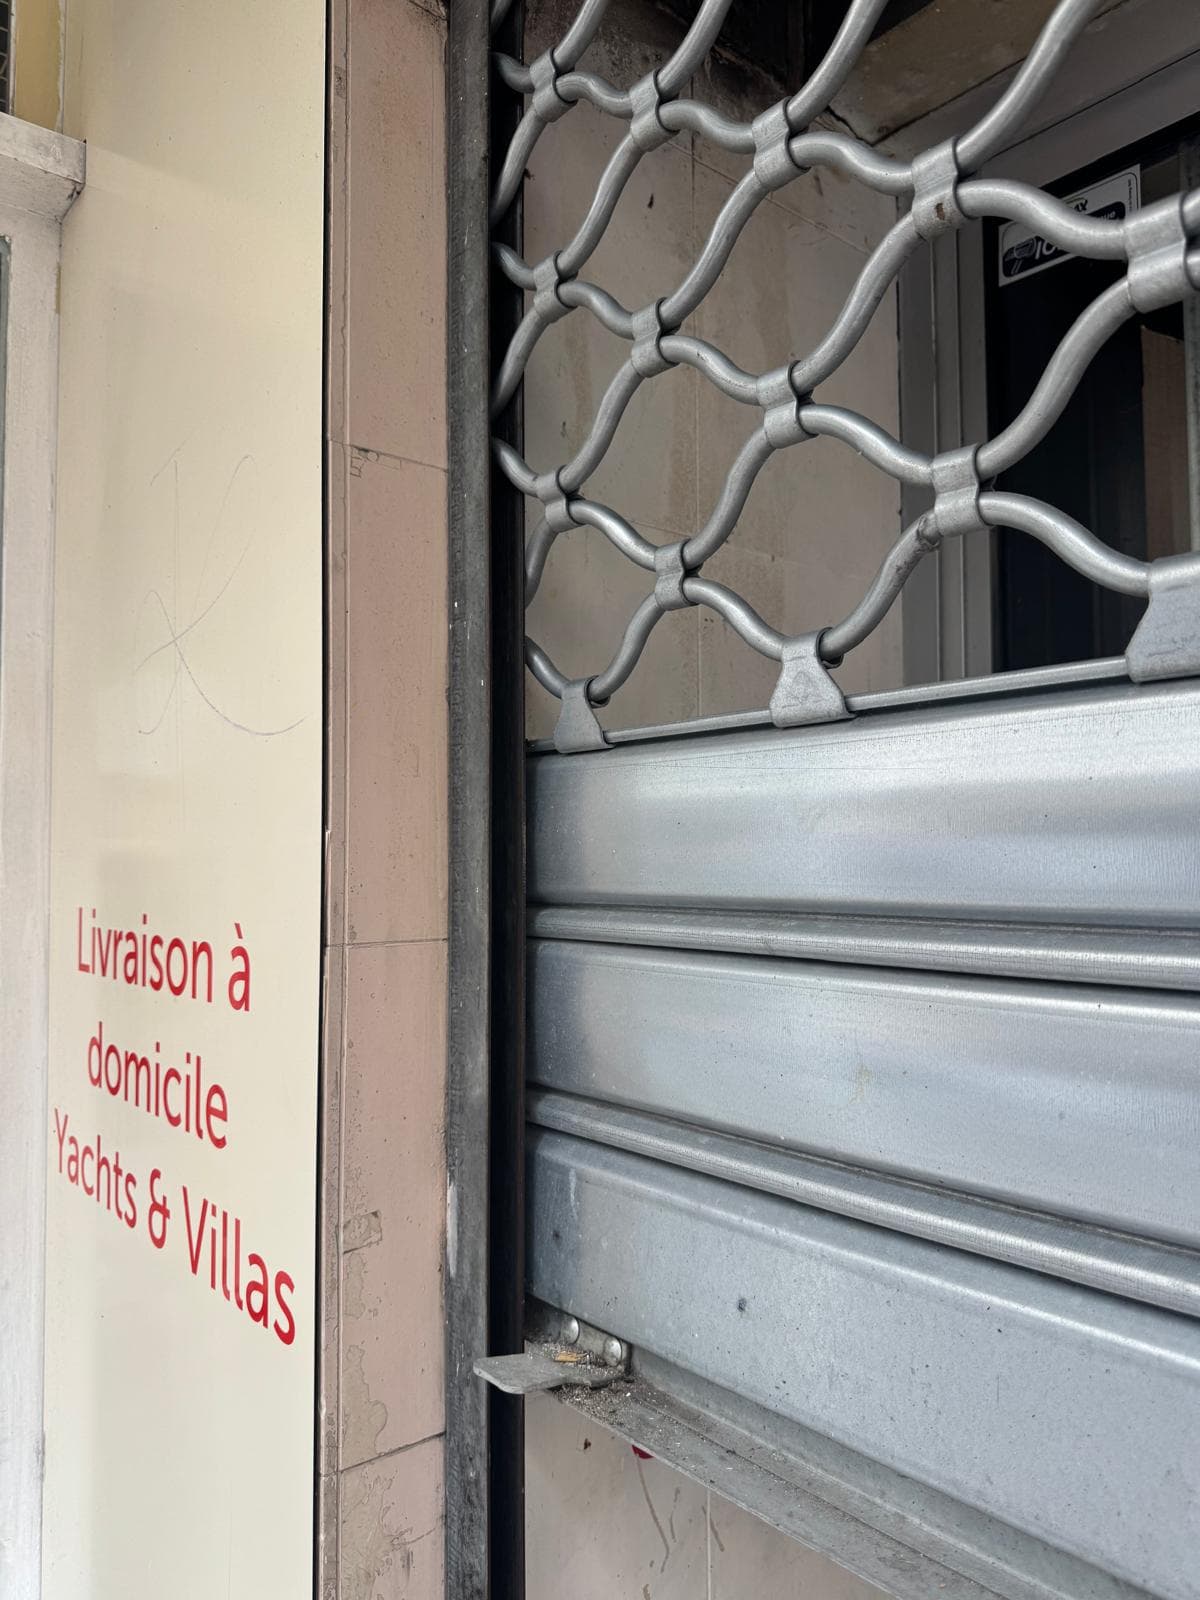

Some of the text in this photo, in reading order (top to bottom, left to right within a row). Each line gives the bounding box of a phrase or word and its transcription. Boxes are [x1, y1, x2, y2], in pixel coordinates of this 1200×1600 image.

[77, 906, 252, 1013] Livraison à
[87, 1020, 229, 1150] domicile
[54, 1107, 297, 1346] Yachts & Villas
